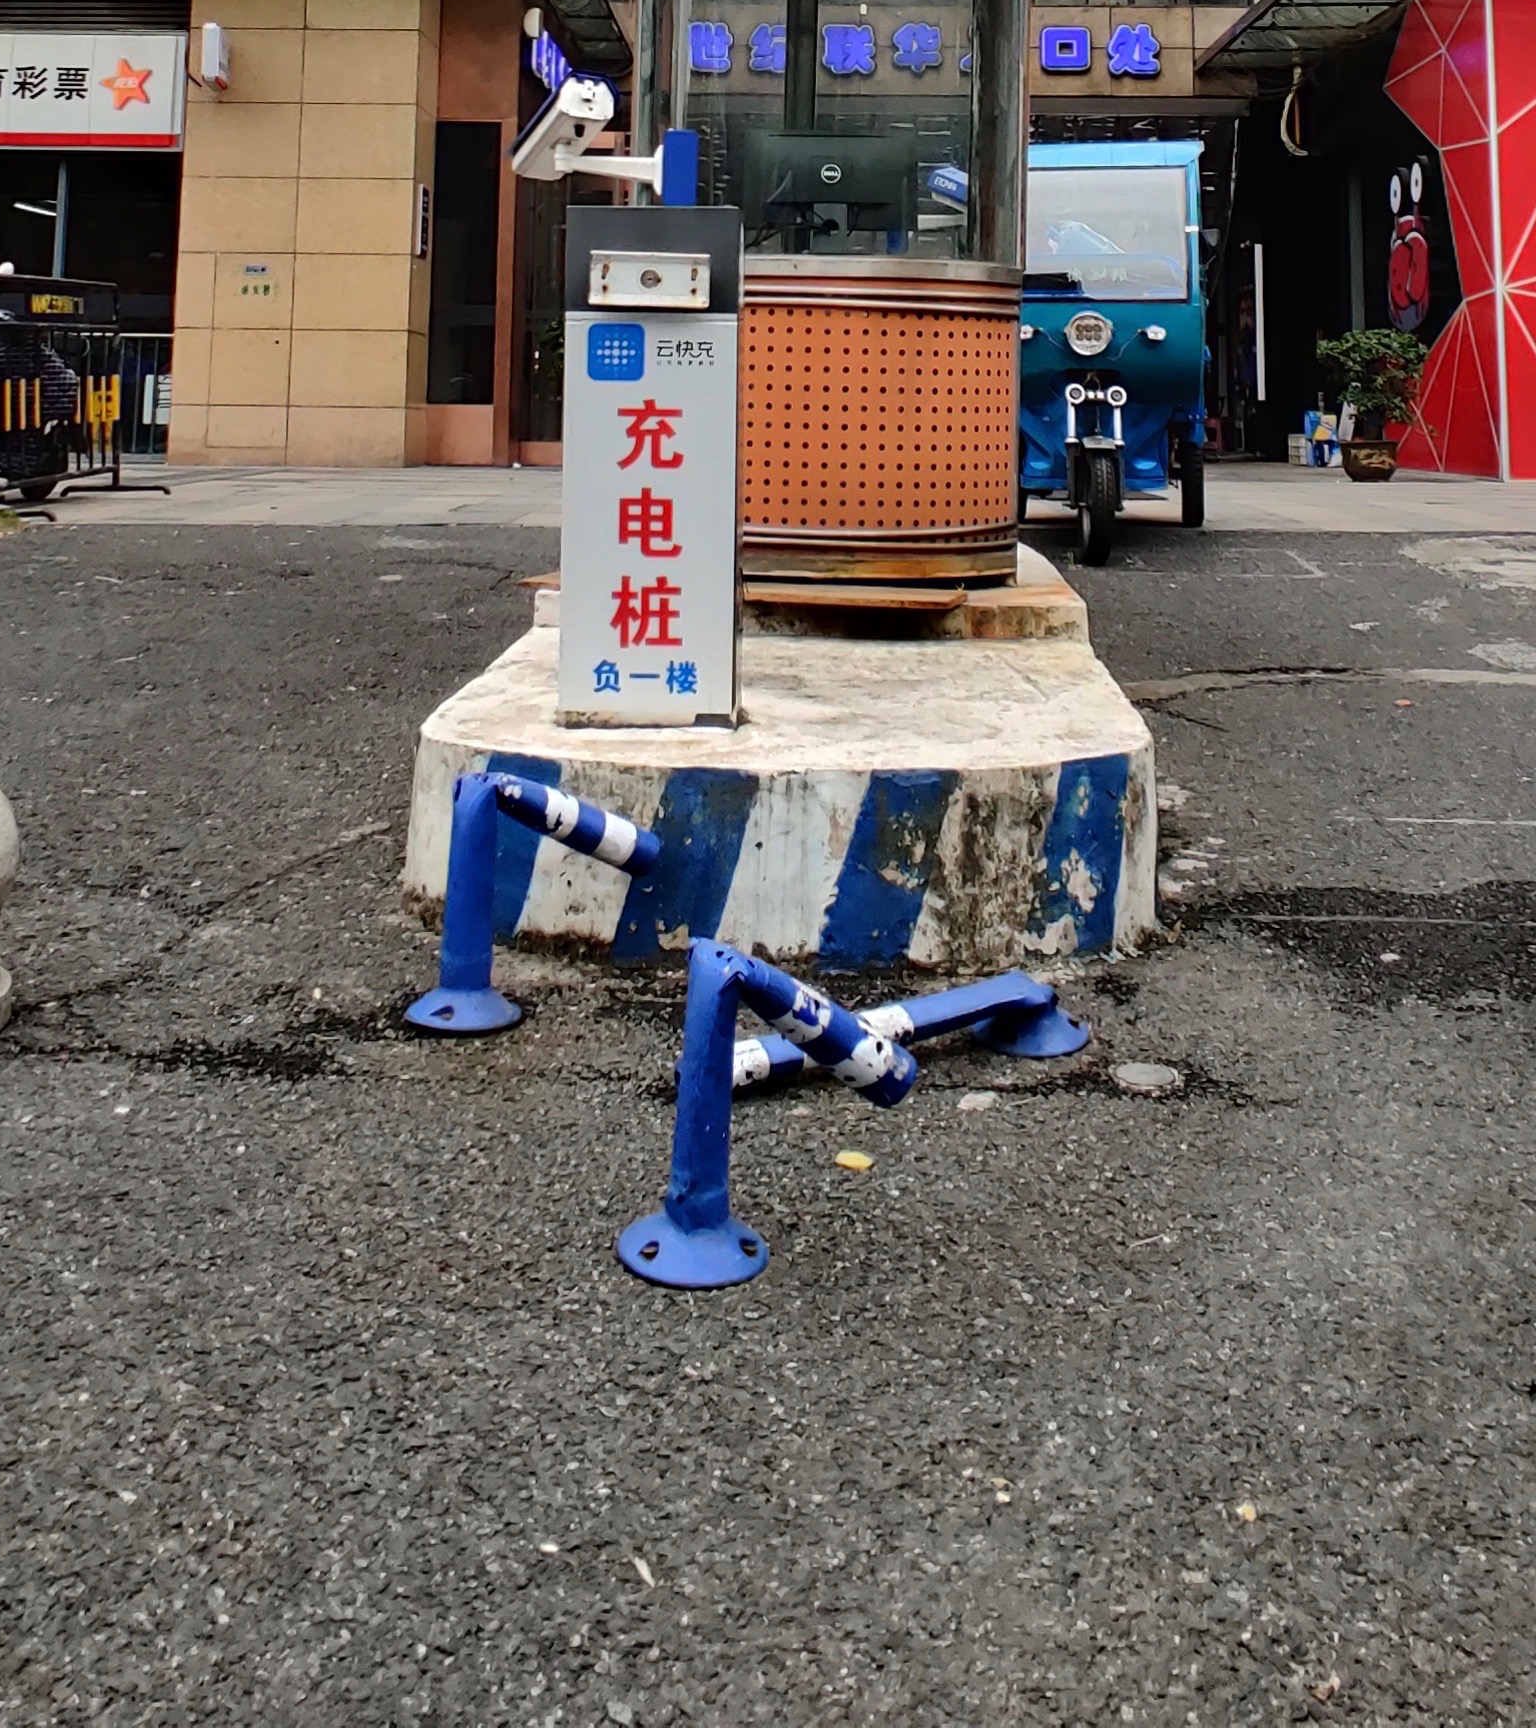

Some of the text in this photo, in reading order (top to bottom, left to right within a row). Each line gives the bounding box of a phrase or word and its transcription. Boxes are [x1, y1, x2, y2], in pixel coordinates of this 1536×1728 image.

[656, 339, 715, 359] 云快充
[610, 398, 684, 649] 充电桩
[593, 659, 699, 695] 负一楼
